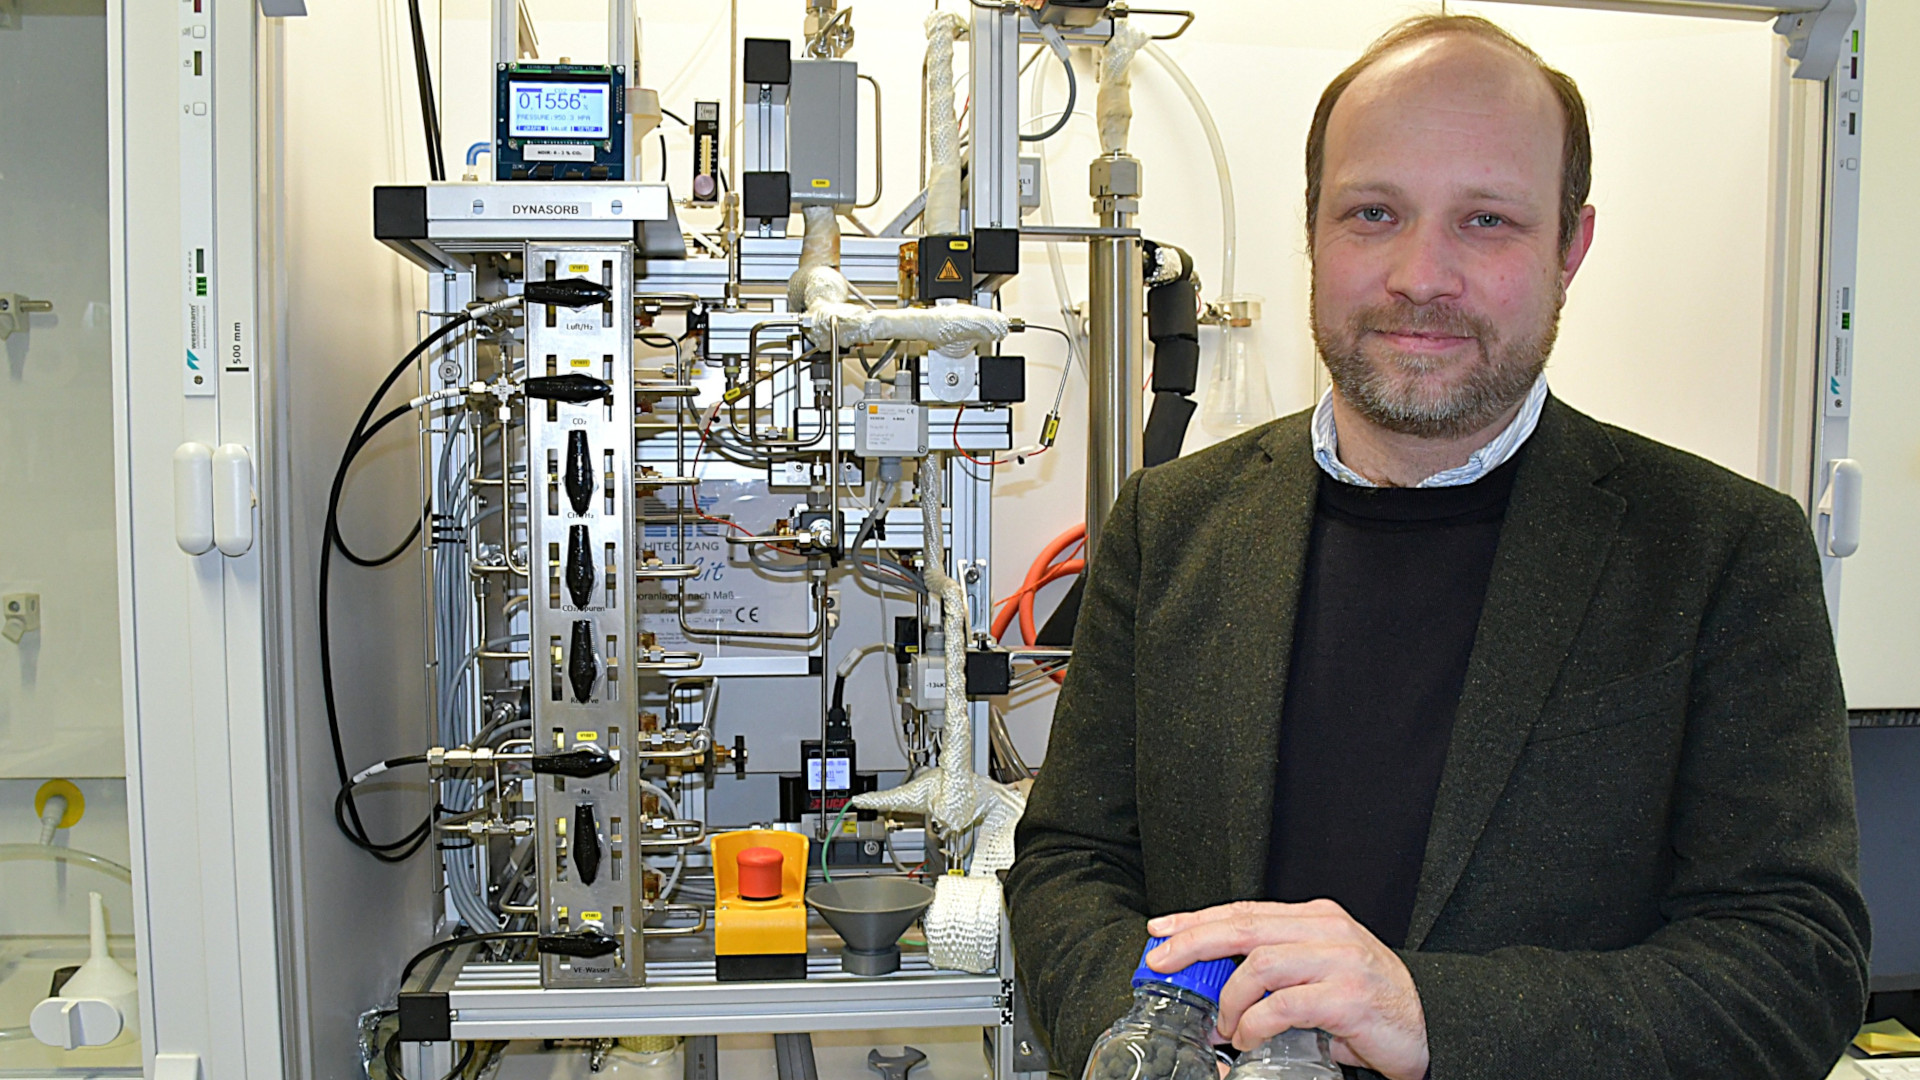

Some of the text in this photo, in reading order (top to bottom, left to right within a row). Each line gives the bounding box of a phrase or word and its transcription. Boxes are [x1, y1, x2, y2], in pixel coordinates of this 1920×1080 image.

[512, 205, 579, 215] DYNASORB
[232, 322, 242, 365] 500 mm
[685, 541, 719, 551] ZANG
[688, 591, 711, 600] nach
[713, 591, 734, 600] Maß
